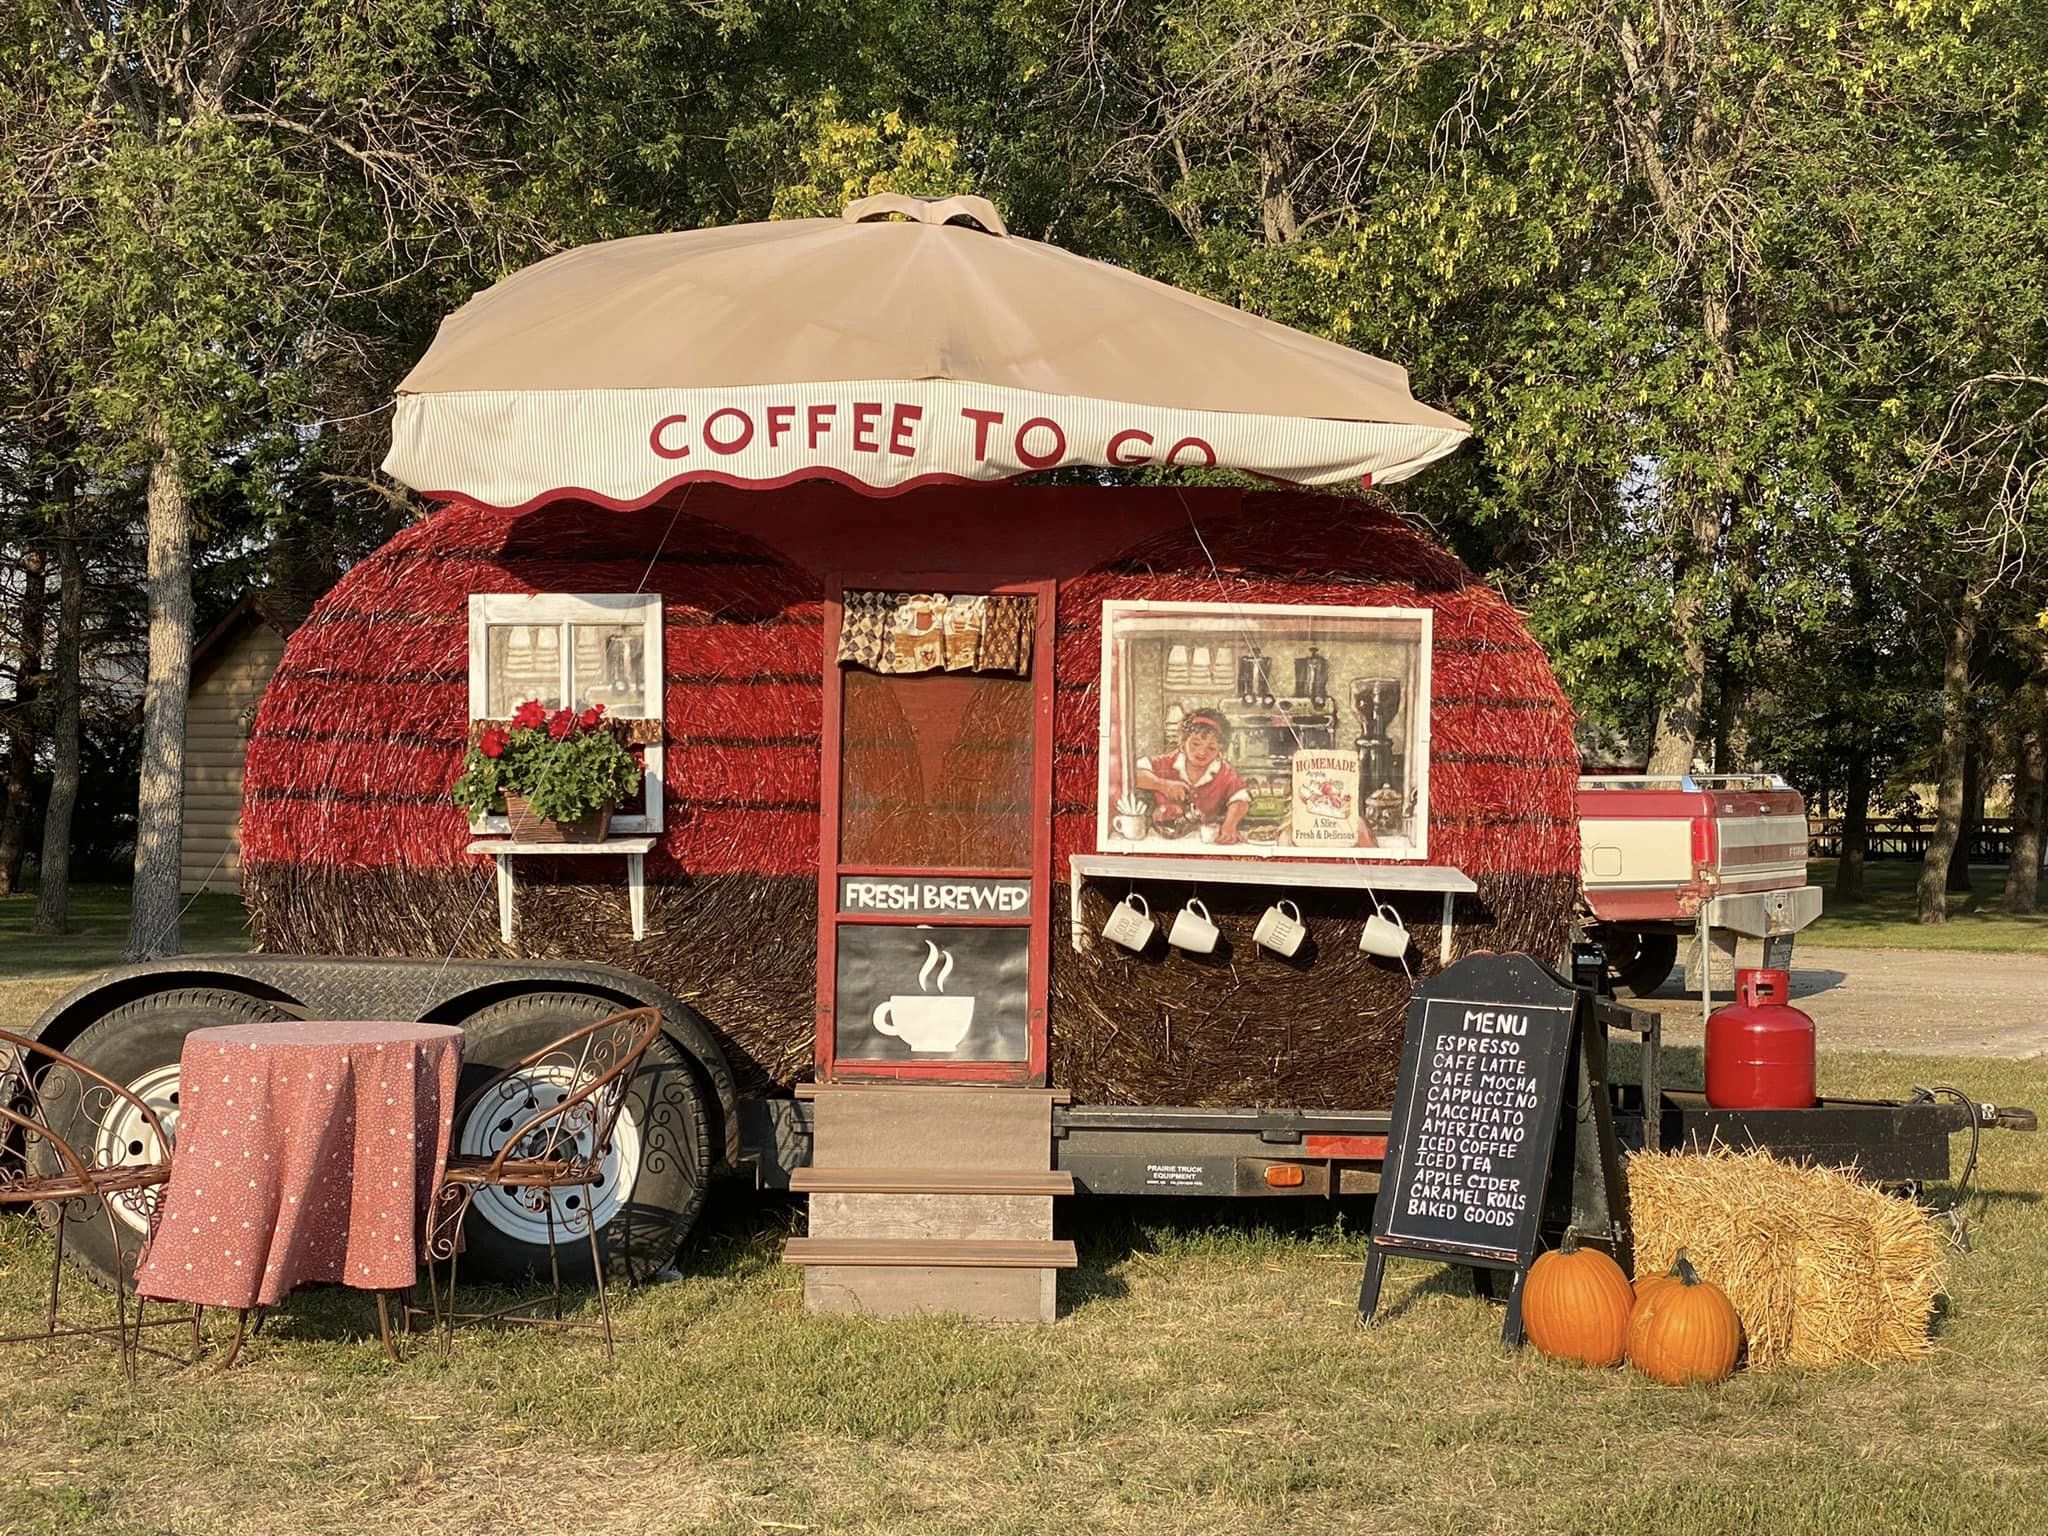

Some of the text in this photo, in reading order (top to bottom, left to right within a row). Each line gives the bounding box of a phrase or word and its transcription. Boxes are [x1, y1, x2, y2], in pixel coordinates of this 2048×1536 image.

[649, 402, 923, 460] COFFEE
[960, 407, 1067, 469] TO
[1295, 757, 1357, 773] HOMEMADE
[1295, 829, 1355, 840] Fresh & Delicious
[1313, 818, 1337, 828] A Slice
[846, 883, 1028, 911] FRESH BREWED
[1266, 919, 1293, 949] COFFEE
[1463, 1010, 1528, 1036] MENU
[1435, 1034, 1521, 1056] ESPRESSO
[1432, 1052, 1527, 1075] CAFE LATTE
[1430, 1069, 1537, 1094] CAFE MOCHA
[1427, 1085, 1538, 1109] CAPPUCCINO
[1425, 1101, 1524, 1126] MACCHIATO
[1421, 1117, 1525, 1143] AMERICANO
[1416, 1134, 1518, 1159] ICED COFFEE
[1414, 1150, 1492, 1174] ICED TEA
[1152, 1172, 1197, 1180] EQUIPMENT
[1413, 1167, 1521, 1193] APPLE CIDER
[1410, 1182, 1527, 1211] CARAMEL ROLLS
[1407, 1198, 1515, 1227] BAKED GOODS
